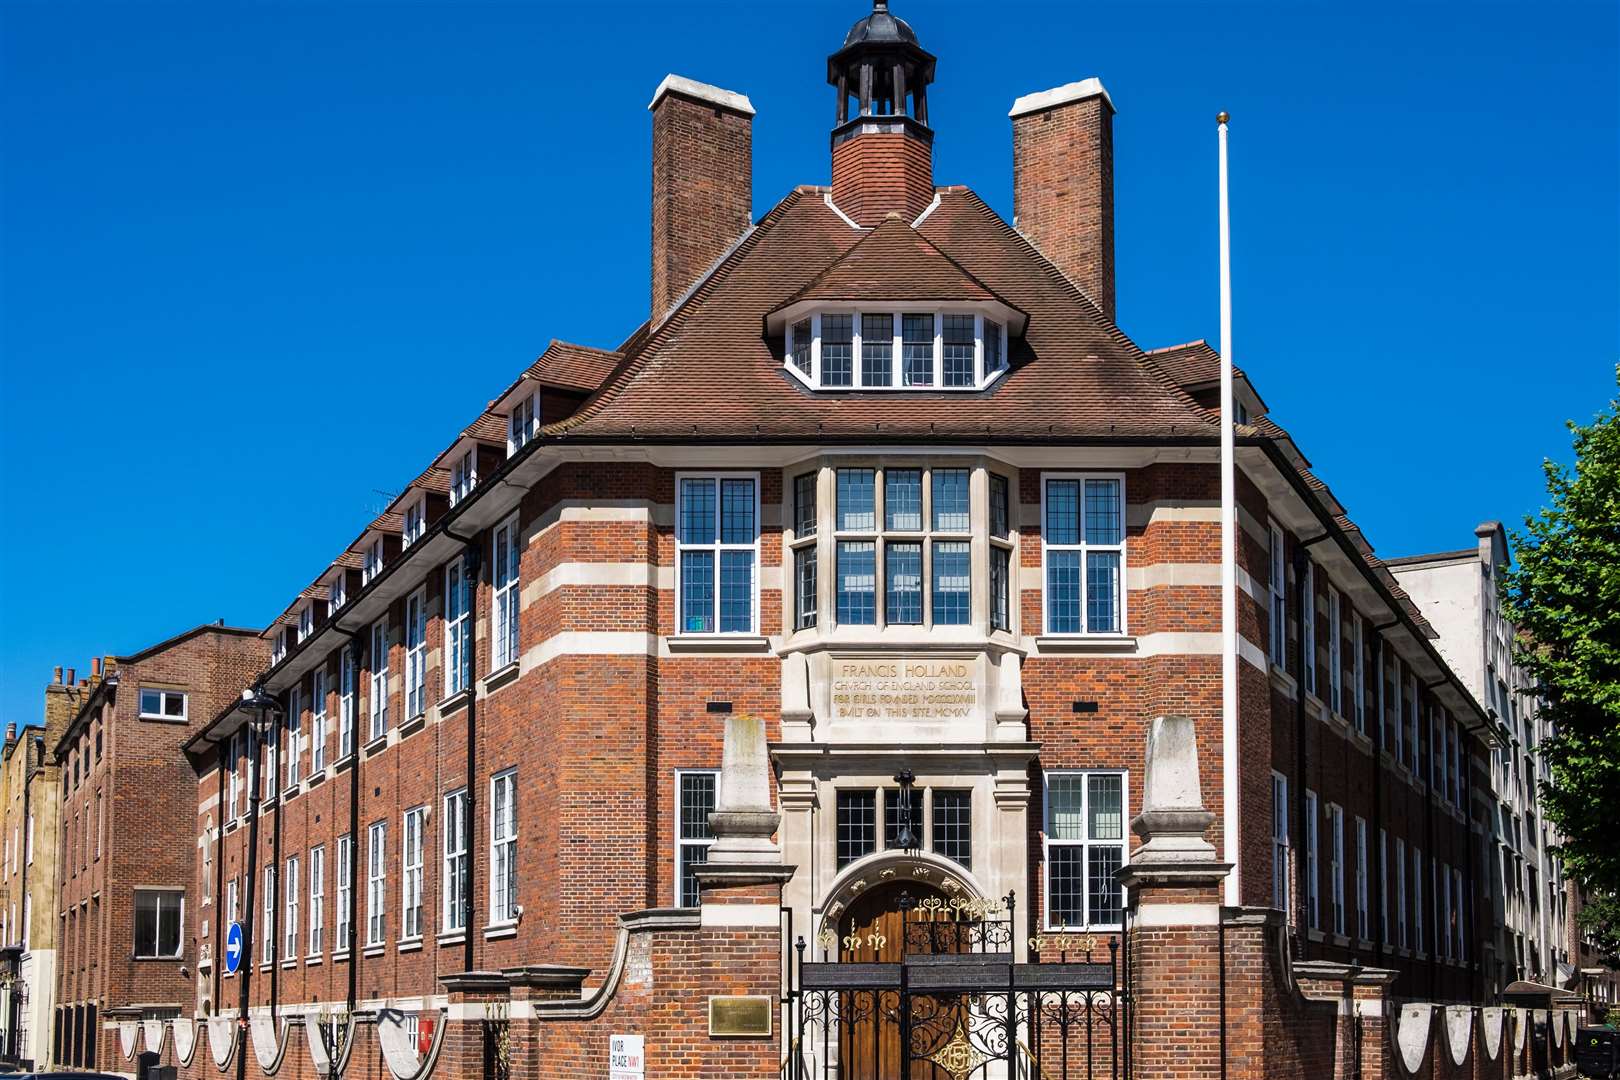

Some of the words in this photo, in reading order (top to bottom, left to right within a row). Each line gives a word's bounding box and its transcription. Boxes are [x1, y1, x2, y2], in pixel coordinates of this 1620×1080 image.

[842, 664, 897, 678] FRANCIS
[905, 664, 967, 678] HOLLAND
[877, 681, 889, 691] OF
[891, 681, 936, 691] ENGLAND
[939, 681, 976, 691] SCHOOL
[866, 707, 881, 717] ON
[886, 707, 908, 717] THIS
[912, 707, 931, 717] SITE
[612, 1040, 624, 1052] IVOR
[612, 1055, 627, 1067] PLACE
[628, 1056, 639, 1067] NW1
